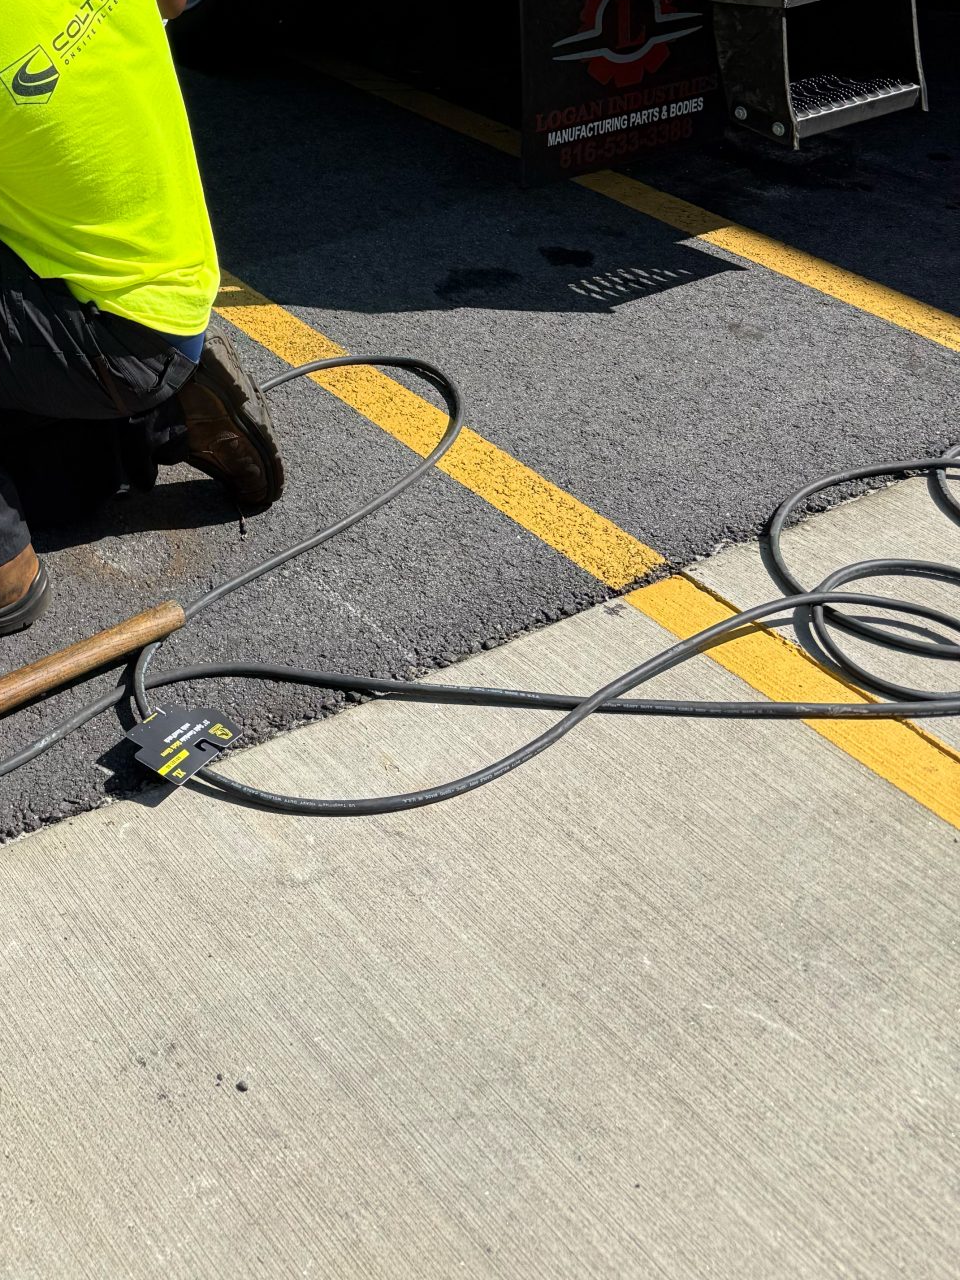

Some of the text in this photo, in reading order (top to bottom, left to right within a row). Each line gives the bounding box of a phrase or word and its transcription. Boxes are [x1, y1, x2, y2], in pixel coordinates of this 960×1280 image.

[64, 28, 97, 66] ONSITE
[535, 74, 719, 133] LOGAN INDUSTRIES
[547, 97, 704, 147] MANUFACTURING PARTS & BODIES
